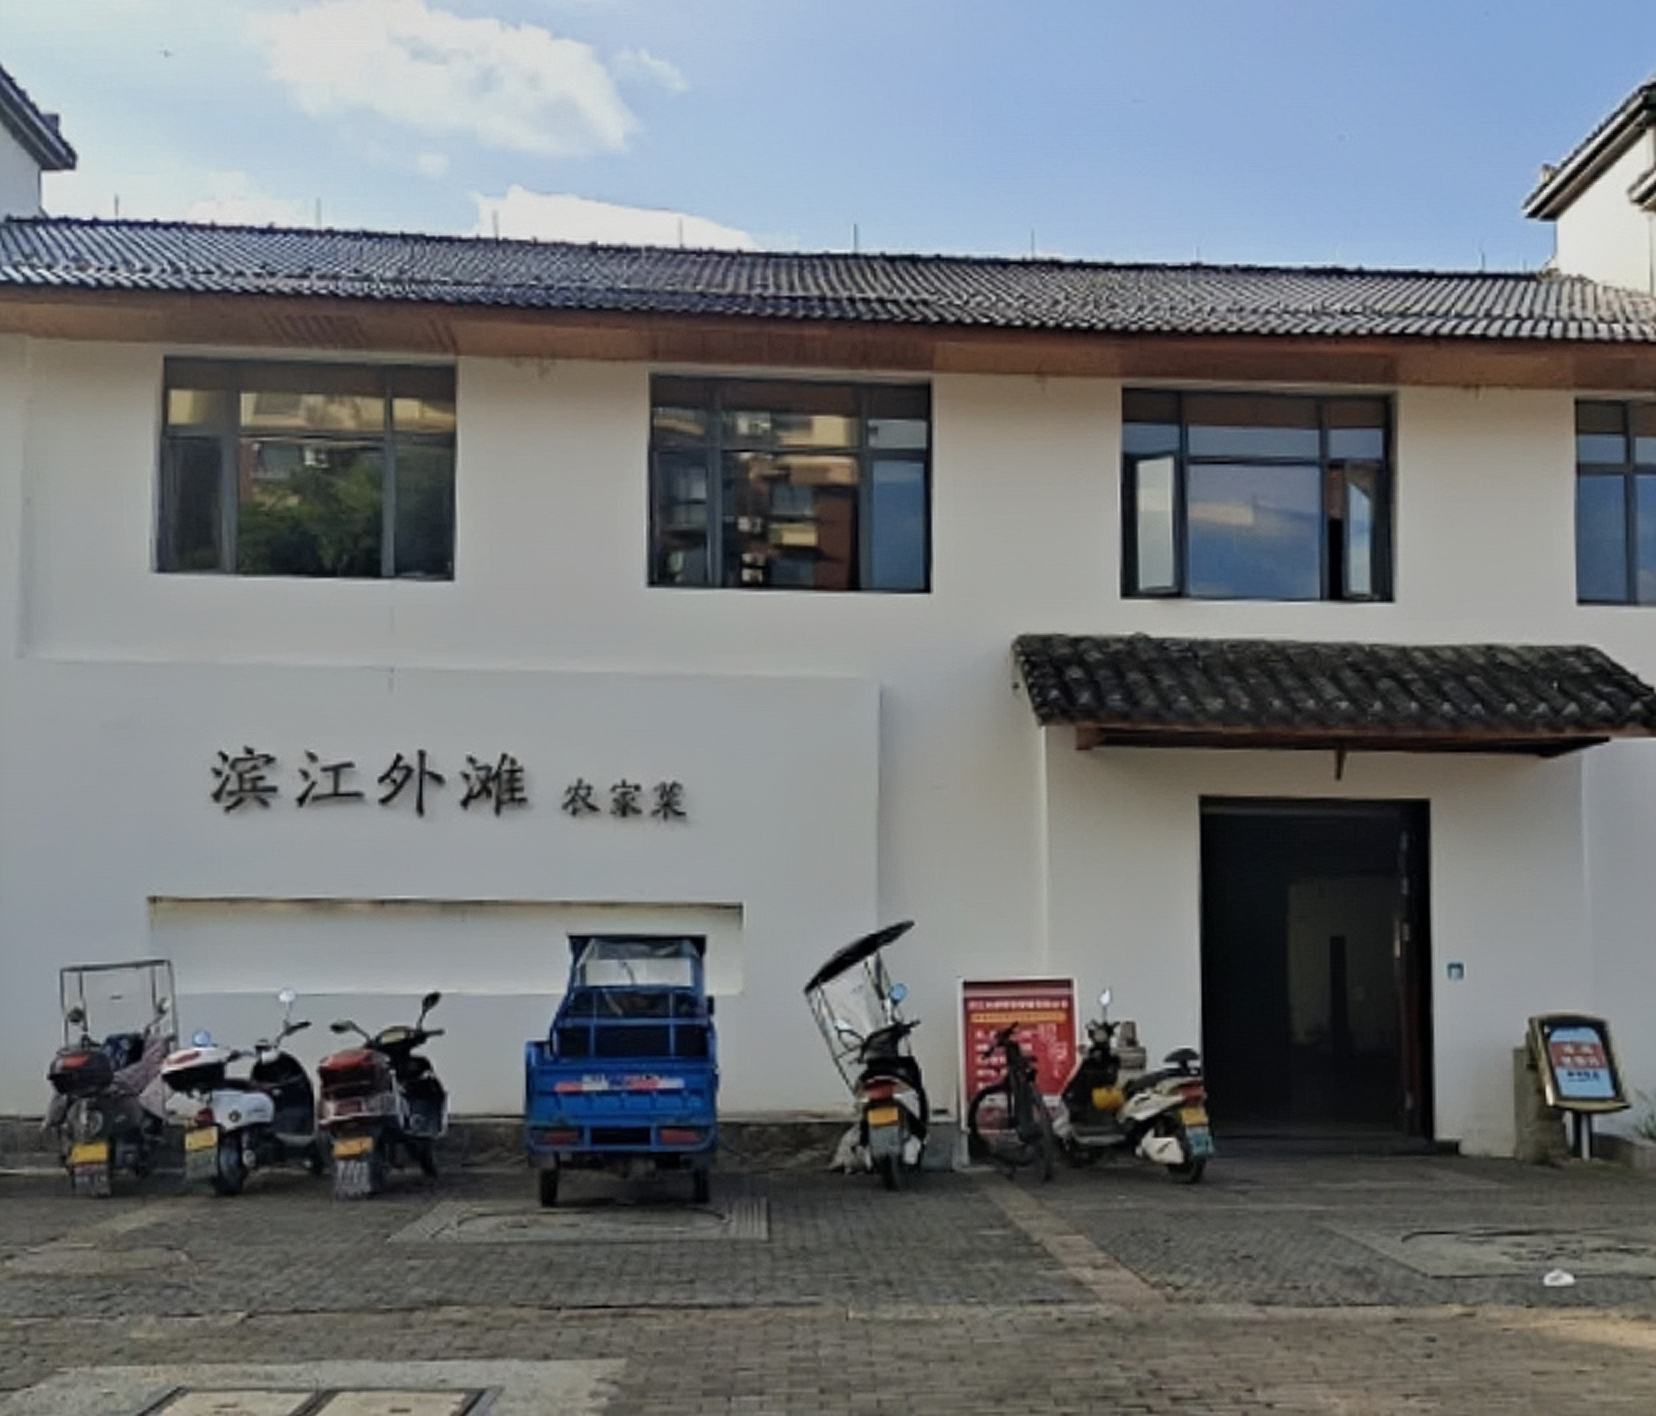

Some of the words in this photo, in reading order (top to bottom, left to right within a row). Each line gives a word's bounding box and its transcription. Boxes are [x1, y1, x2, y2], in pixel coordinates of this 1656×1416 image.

[210, 746, 528, 817] 滨江外滩
[561, 777, 687, 820] 农家菜
